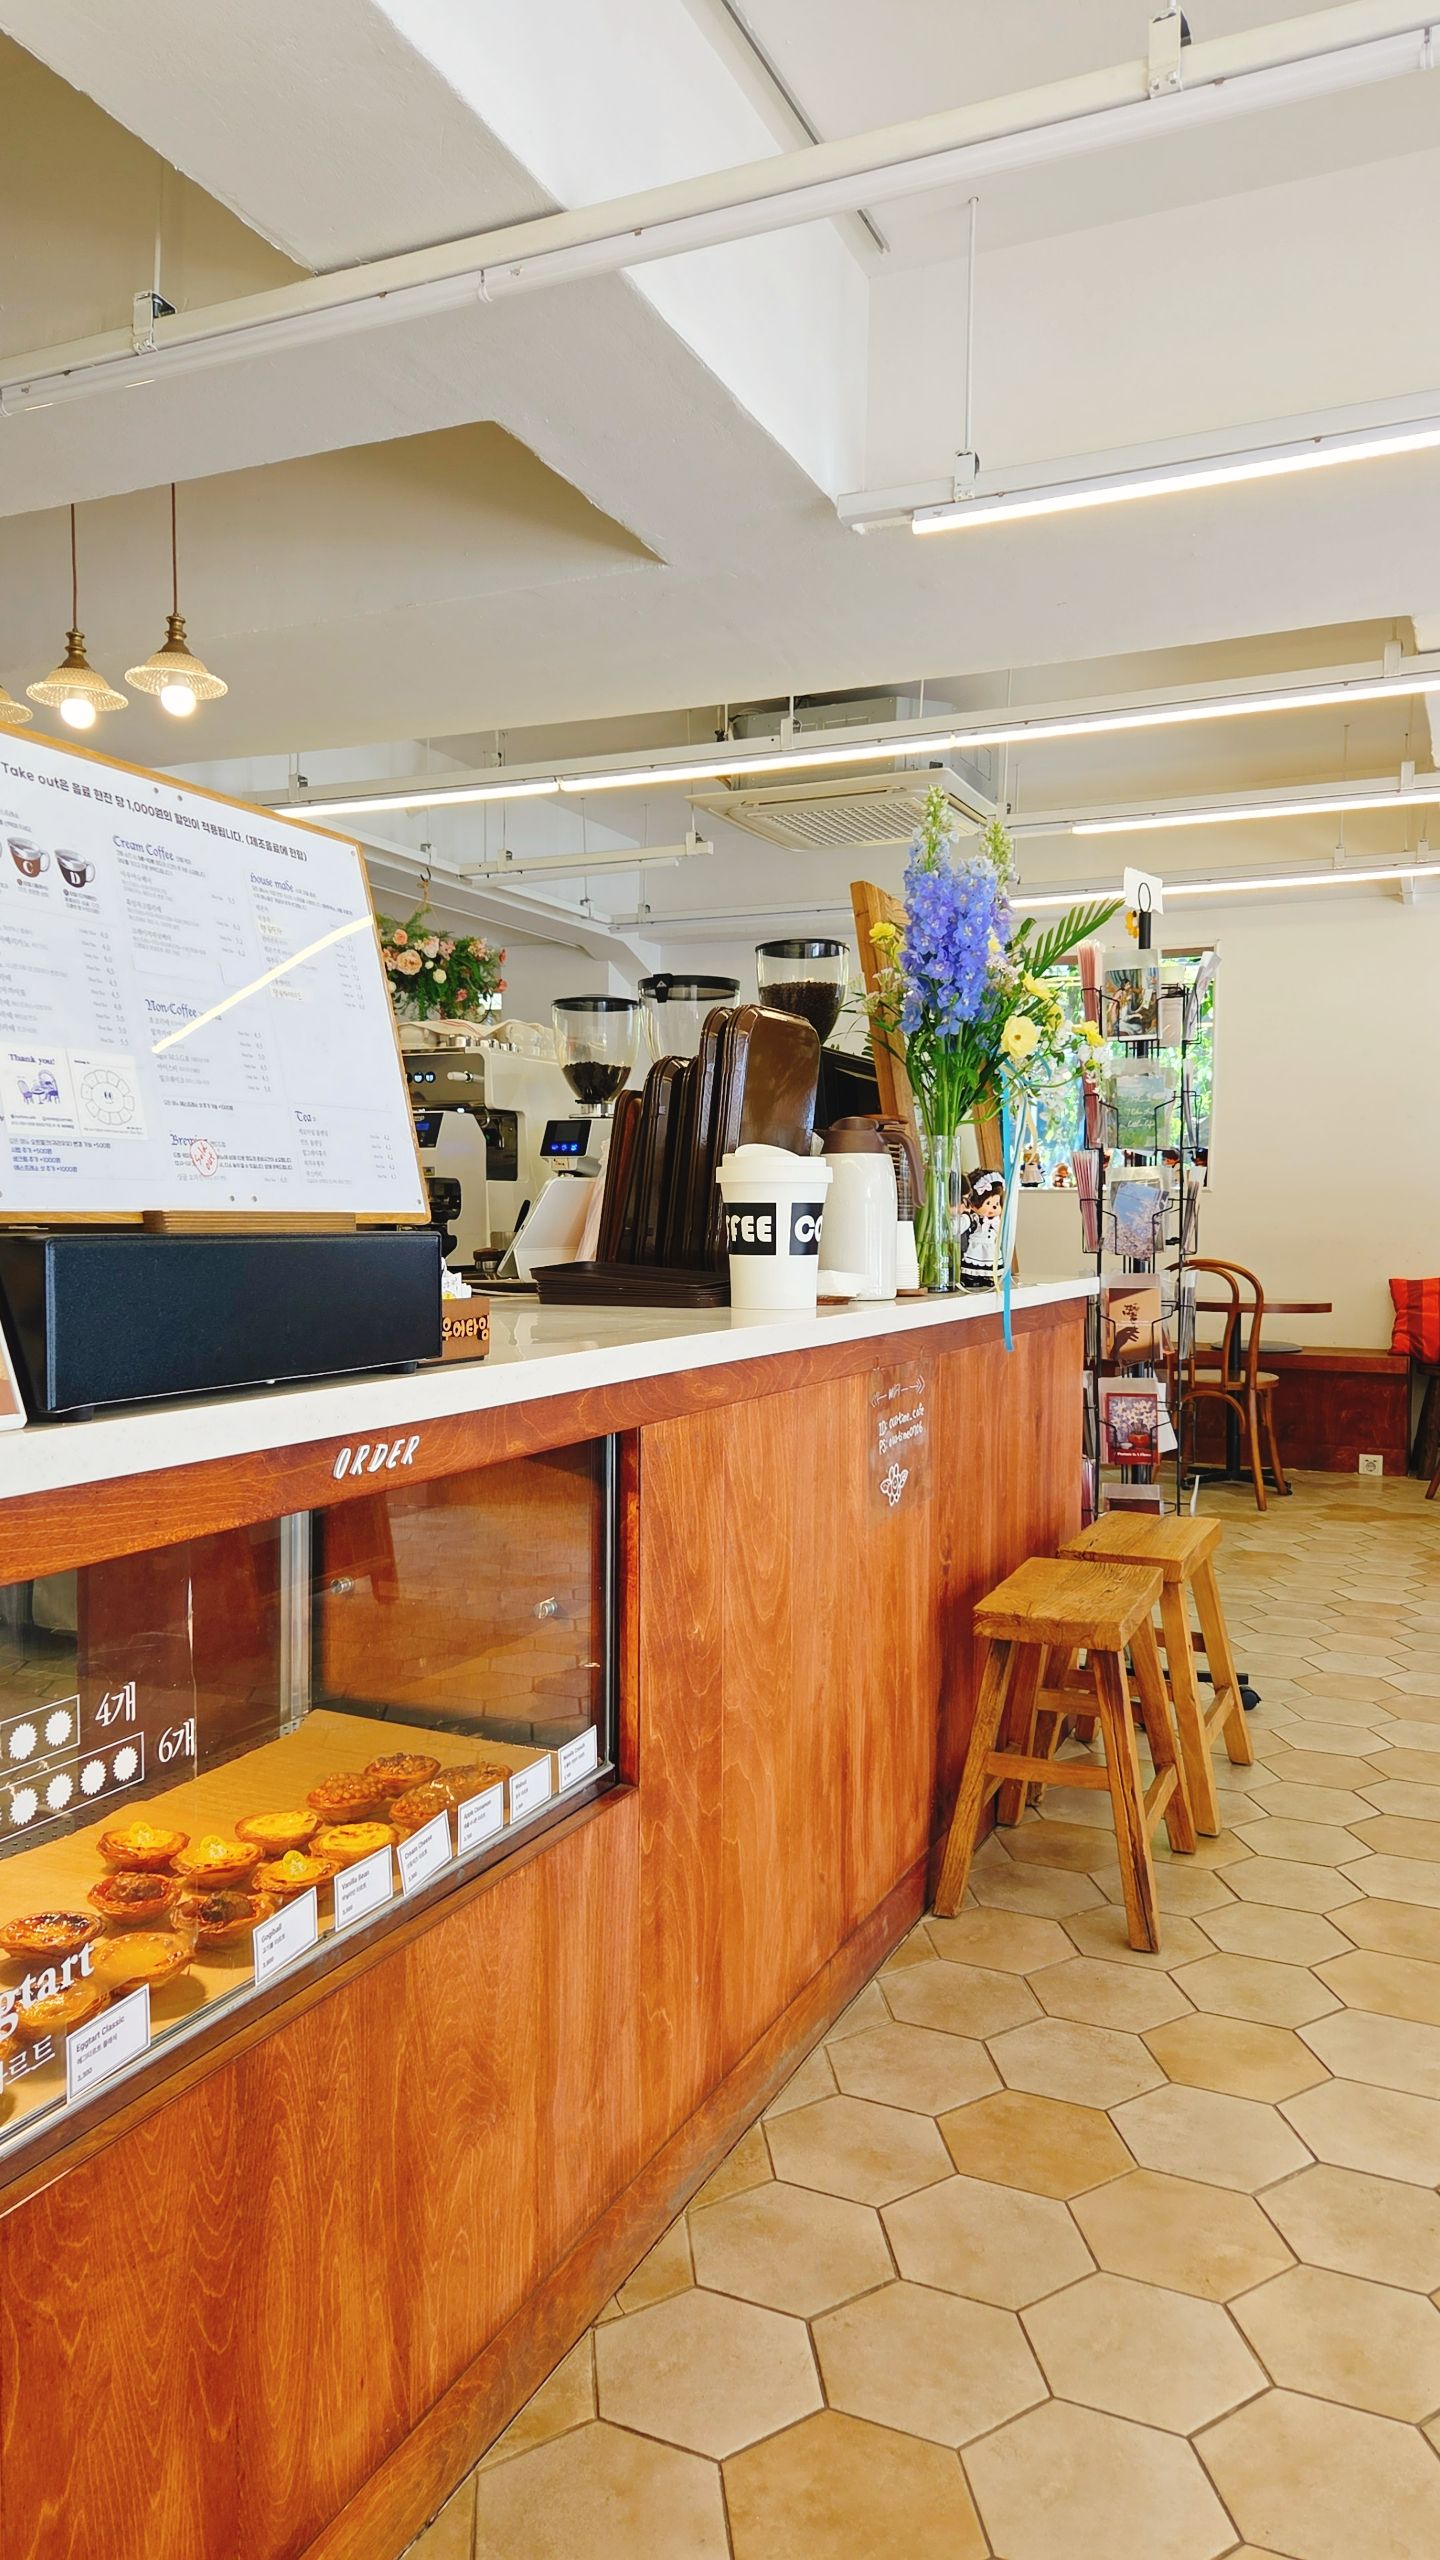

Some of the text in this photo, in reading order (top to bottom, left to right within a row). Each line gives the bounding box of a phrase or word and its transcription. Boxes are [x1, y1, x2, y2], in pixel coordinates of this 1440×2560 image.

[1, 762, 34, 781] Take
[38, 774, 69, 792] out은
[72, 782, 92, 798] 음료
[94, 788, 113, 805] 한잔
[115, 795, 125, 808] 당
[127, 799, 172, 822] 1,000원의
[174, 812, 200, 830] 할인이
[202, 821, 245, 843] 적용됩니다.
[112, 835, 145, 853] Cream
[145, 843, 174, 861] Coffee
[22, 860, 33, 874] C
[70, 871, 81, 885] D
[8, 1053, 55, 1066] Thank you!
[295, 1110, 312, 1122] Tea
[333, 1435, 420, 1480] ORDER
[95, 1681, 136, 1727] 4개
[158, 1717, 195, 1763] 6개
[76, 2015, 125, 2053] Eggtart Classic
